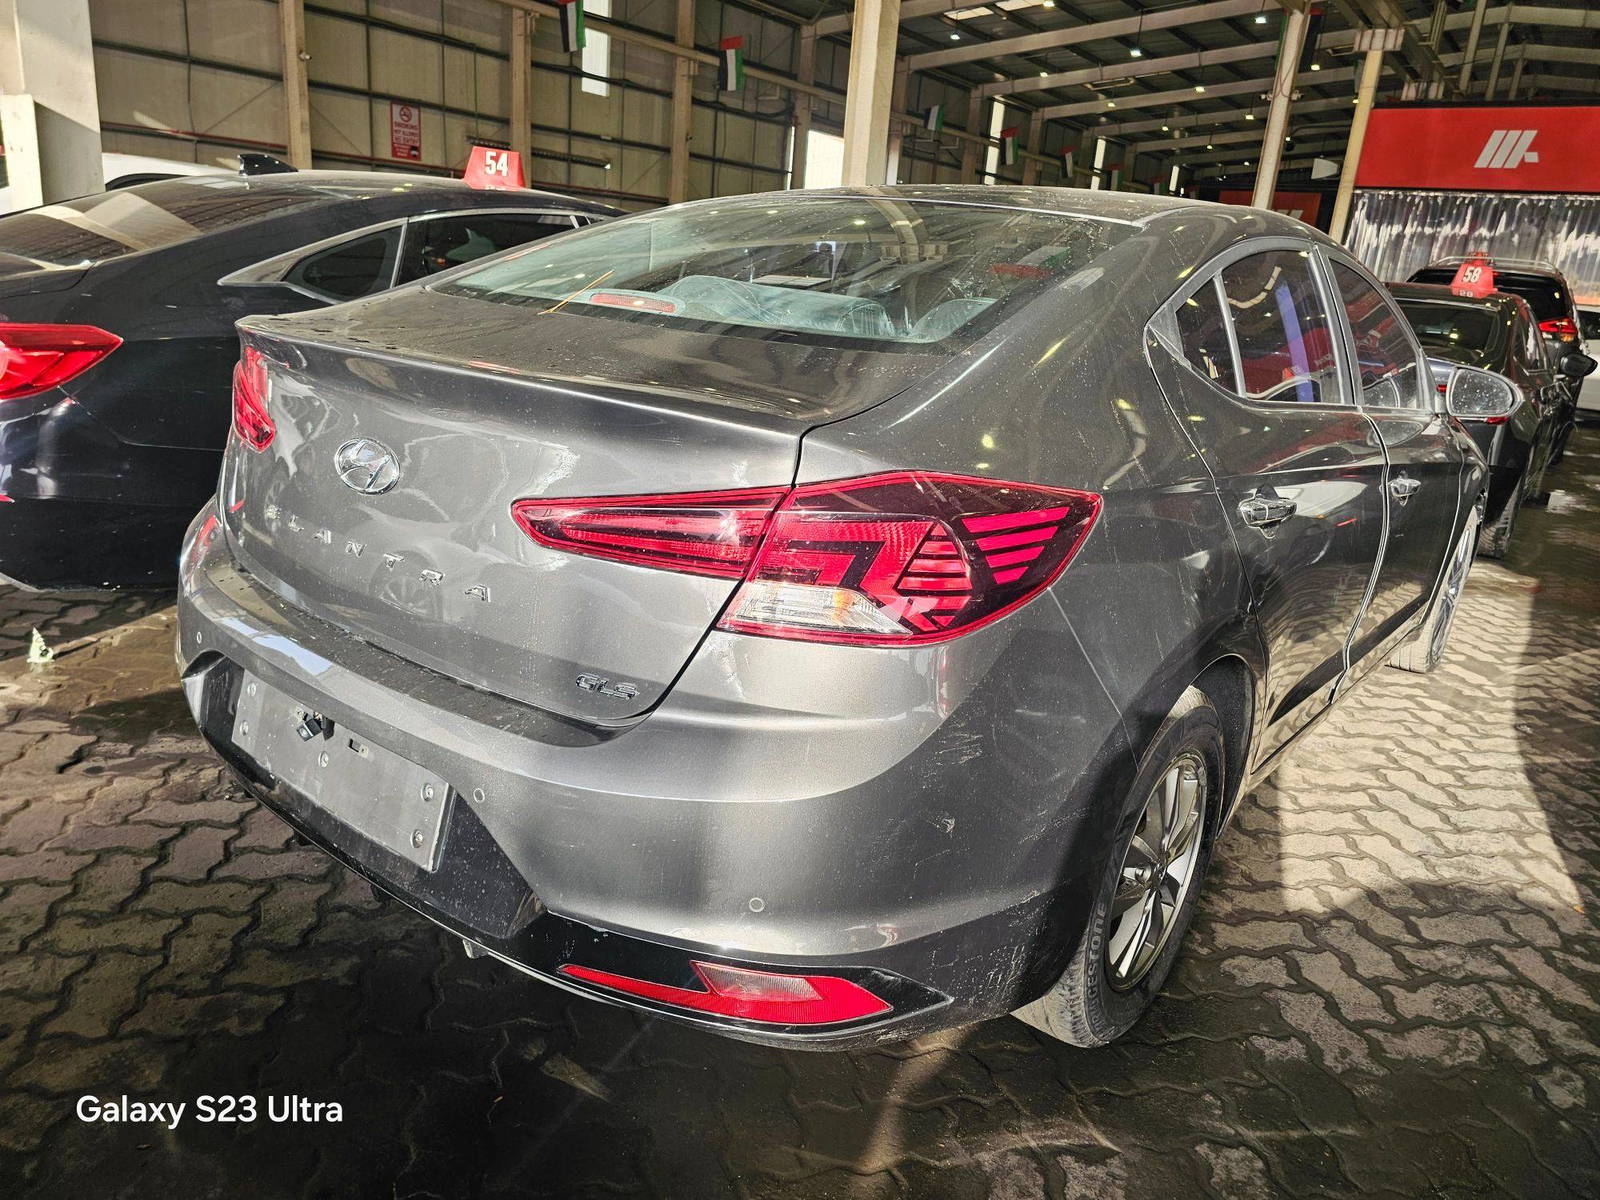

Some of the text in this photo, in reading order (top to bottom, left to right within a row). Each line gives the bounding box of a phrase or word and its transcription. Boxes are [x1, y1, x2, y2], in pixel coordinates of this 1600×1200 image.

[485, 151, 508, 177] 54
[1462, 266, 1482, 283] 58
[264, 503, 492, 602] ELANTRA
[576, 673, 640, 700] GLS
